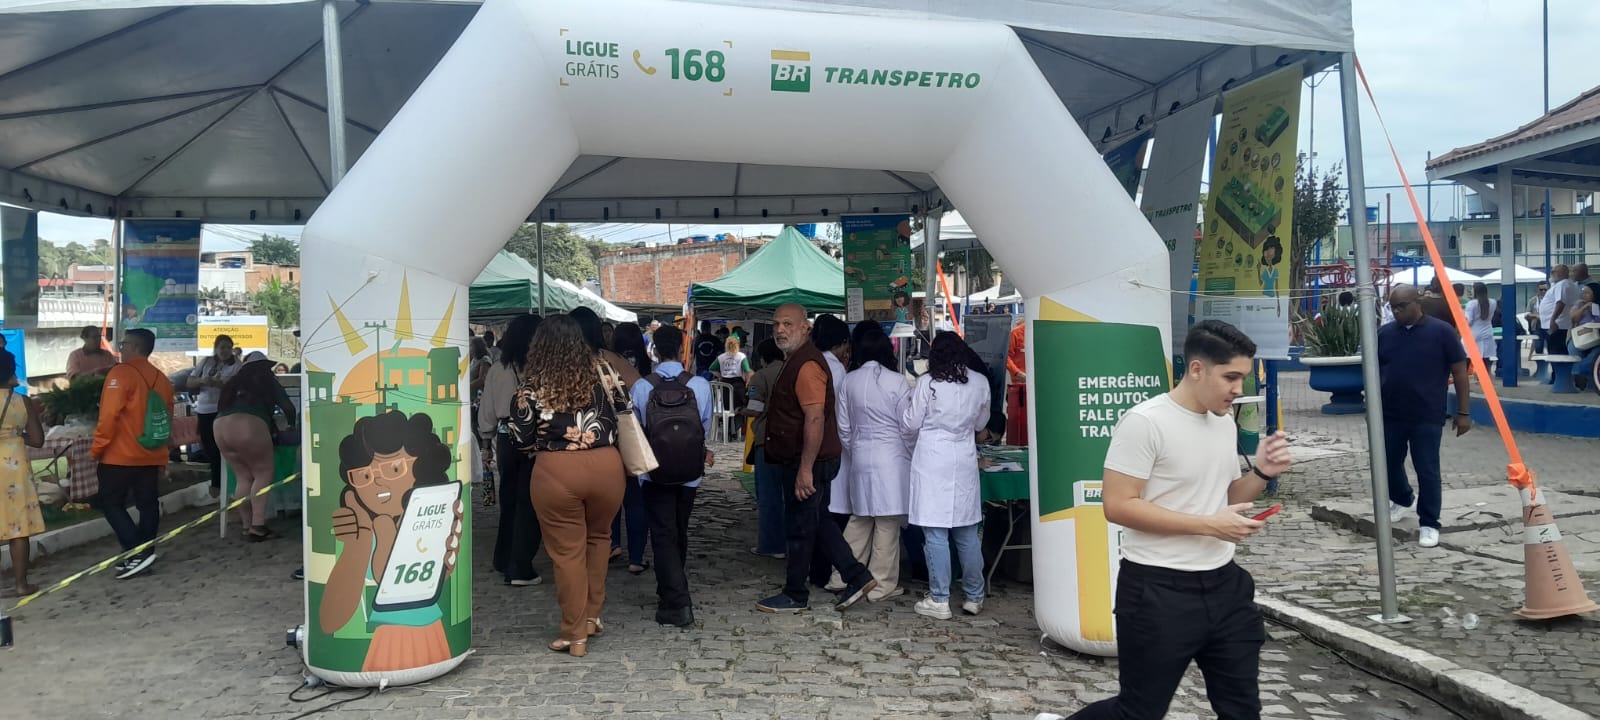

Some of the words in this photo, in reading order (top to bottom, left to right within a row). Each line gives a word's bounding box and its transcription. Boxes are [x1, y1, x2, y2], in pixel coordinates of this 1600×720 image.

[566, 39, 619, 58] LIGUE
[565, 60, 619, 79] GRÁTIS
[664, 48, 726, 83] 168
[775, 64, 807, 82] BR
[824, 67, 981, 89] TRANSPETRO
[1078, 372, 1161, 389] EMERGÊNCIA
[1078, 393, 1099, 405] EM
[1103, 391, 1149, 405] DUTOS
[1079, 408, 1114, 421] FALE
[1085, 488, 1103, 498] BR
[416, 503, 447, 517] LIGUE
[412, 518, 443, 532] GRÁTIS
[393, 560, 435, 585] 168
